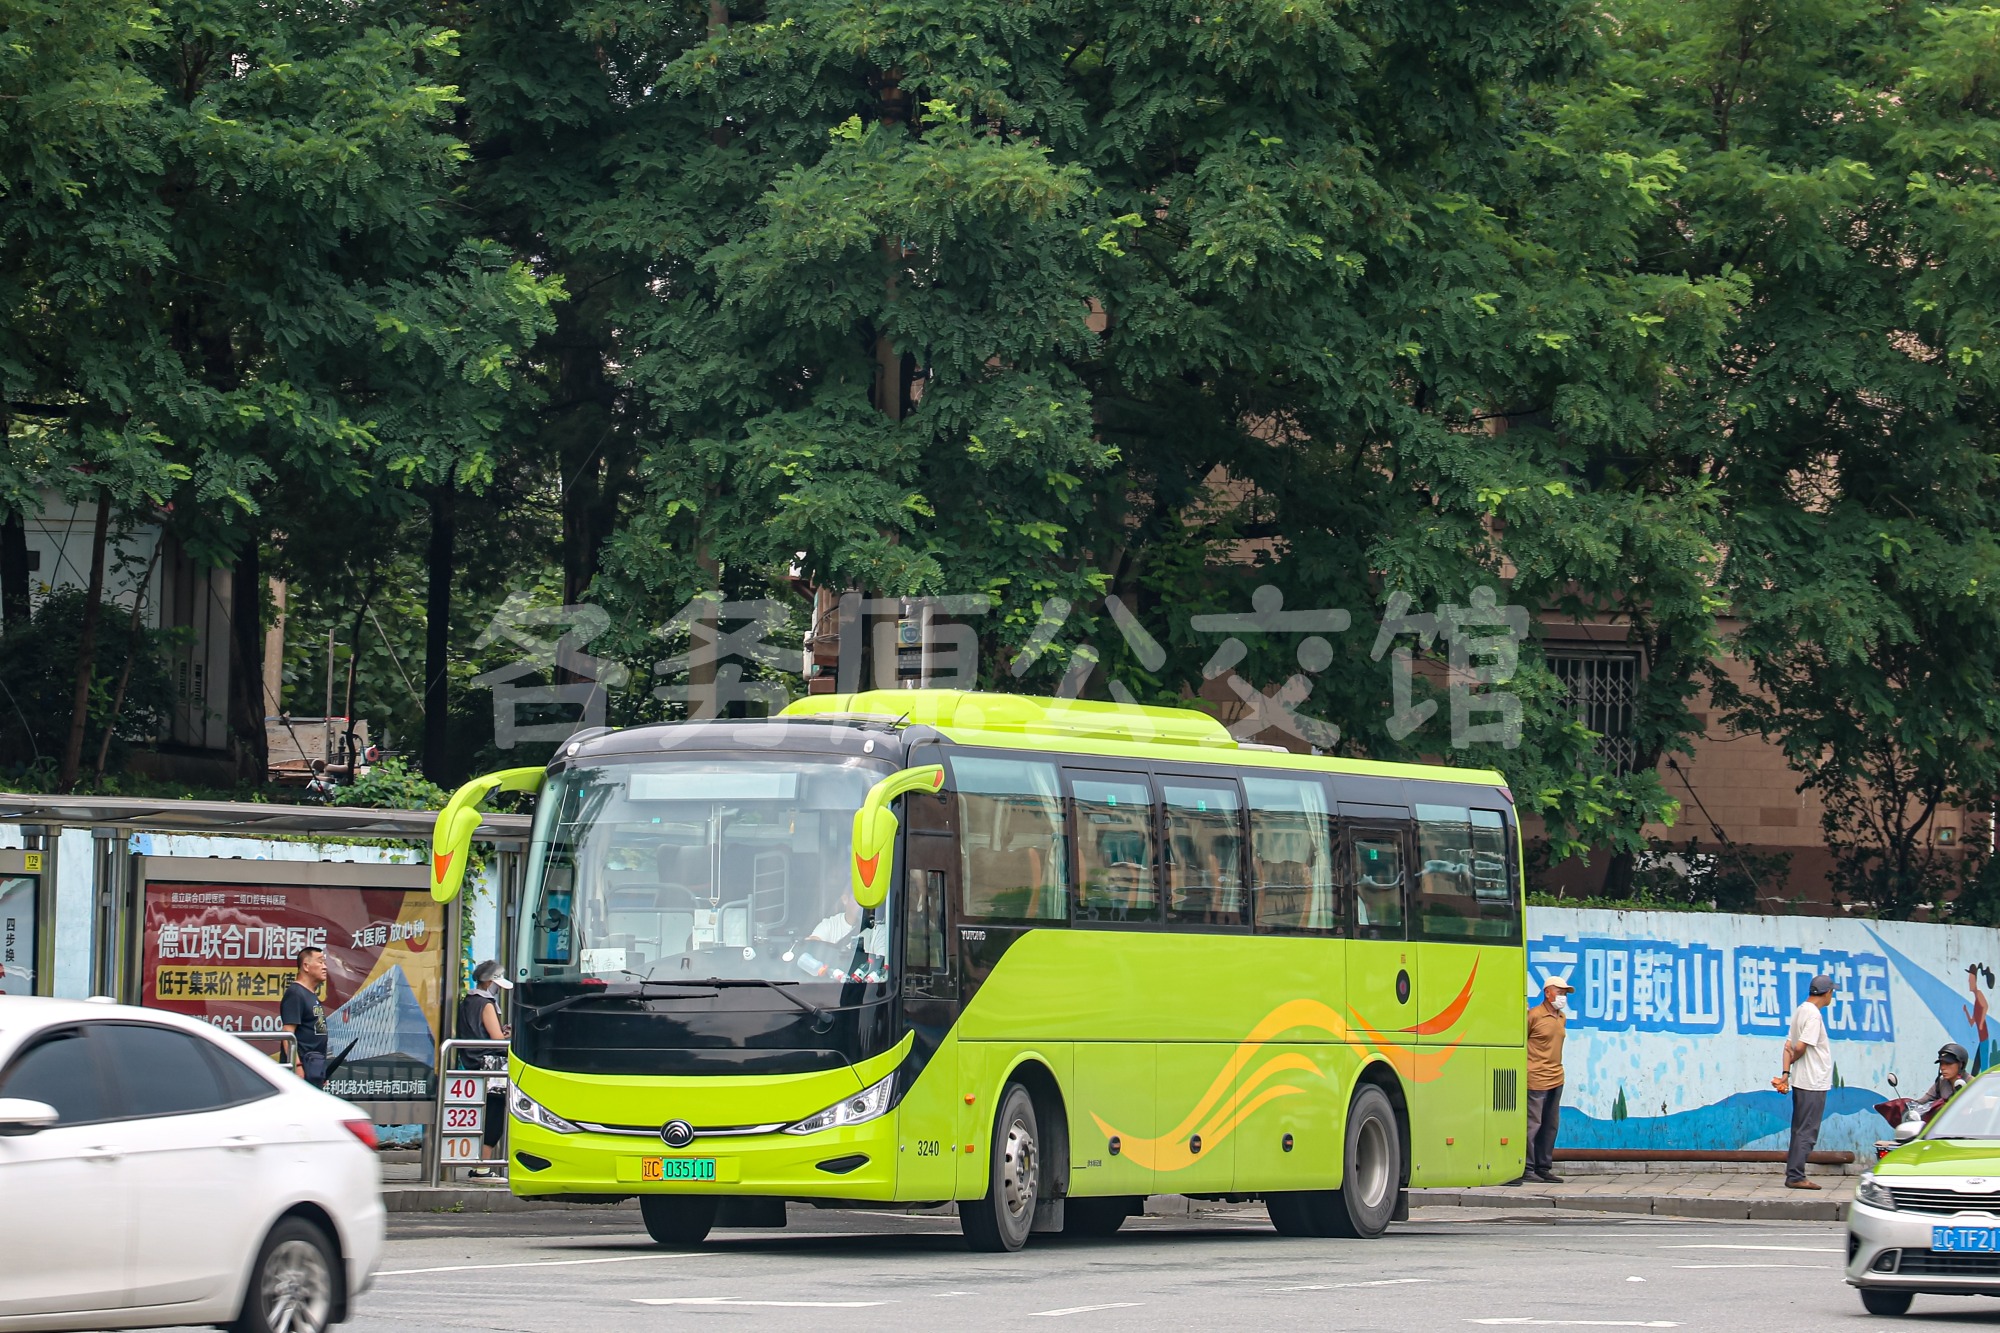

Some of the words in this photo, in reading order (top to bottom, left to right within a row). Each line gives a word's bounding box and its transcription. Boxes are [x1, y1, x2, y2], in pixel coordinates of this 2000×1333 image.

[171, 892, 225, 904] 德立联合口腔医院
[233, 894, 286, 906] 二级口腔专科医院
[157, 923, 327, 960] 德立联合口腔医院
[351, 926, 387, 949] 大医院
[390, 919, 425, 942] 放心种
[961, 930, 986, 940] YUTONG
[158, 970, 233, 996] 低于集采价
[450, 1079, 476, 1098] 40
[447, 1109, 477, 1127] 323
[447, 1138, 471, 1157] 10
[917, 1140, 939, 1156] 3240
